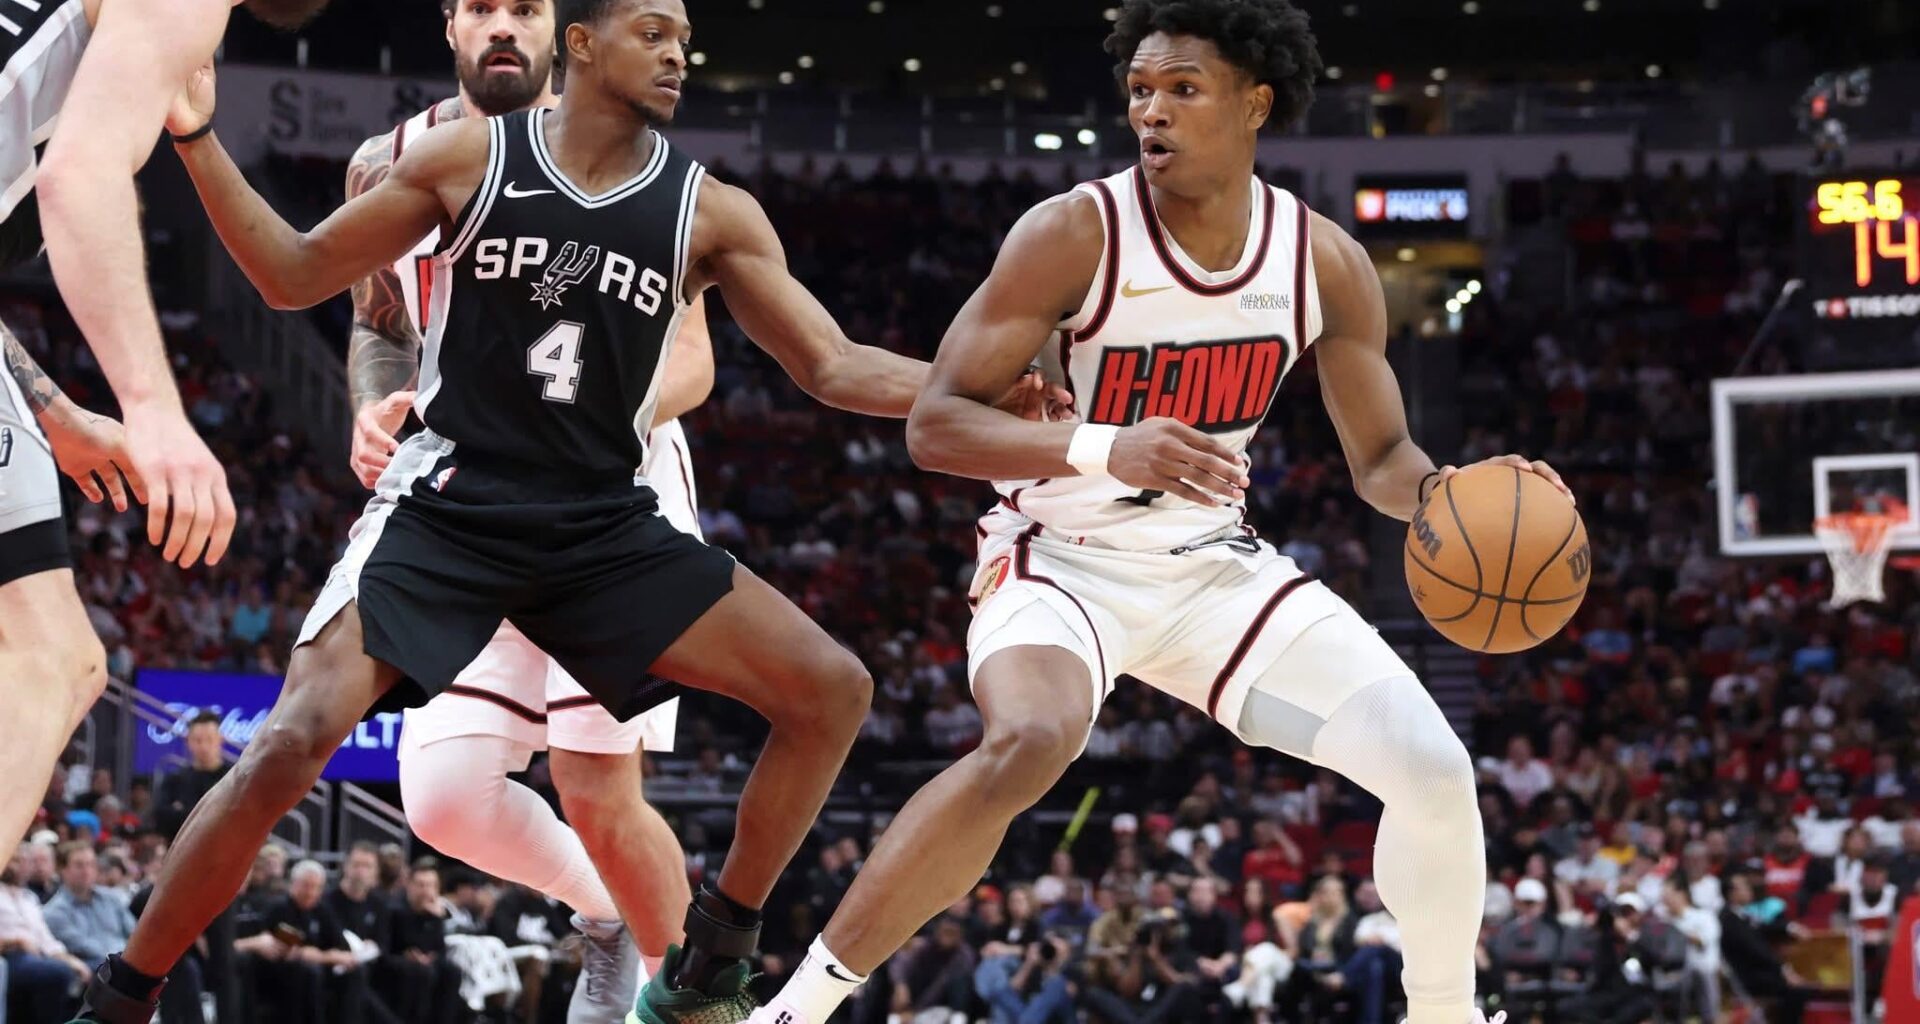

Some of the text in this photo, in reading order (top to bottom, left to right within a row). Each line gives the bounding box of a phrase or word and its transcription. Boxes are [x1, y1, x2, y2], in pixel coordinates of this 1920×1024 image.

[475, 236, 668, 317] SPURS
[1855, 216, 1919, 287] 14
[1240, 293, 1290, 303] MEMORIAL
[1240, 301, 1289, 310] HERMANN
[1848, 294, 1920, 318] TISSO
[526, 320, 585, 404] 4
[1090, 337, 1285, 430] H-TOWN
